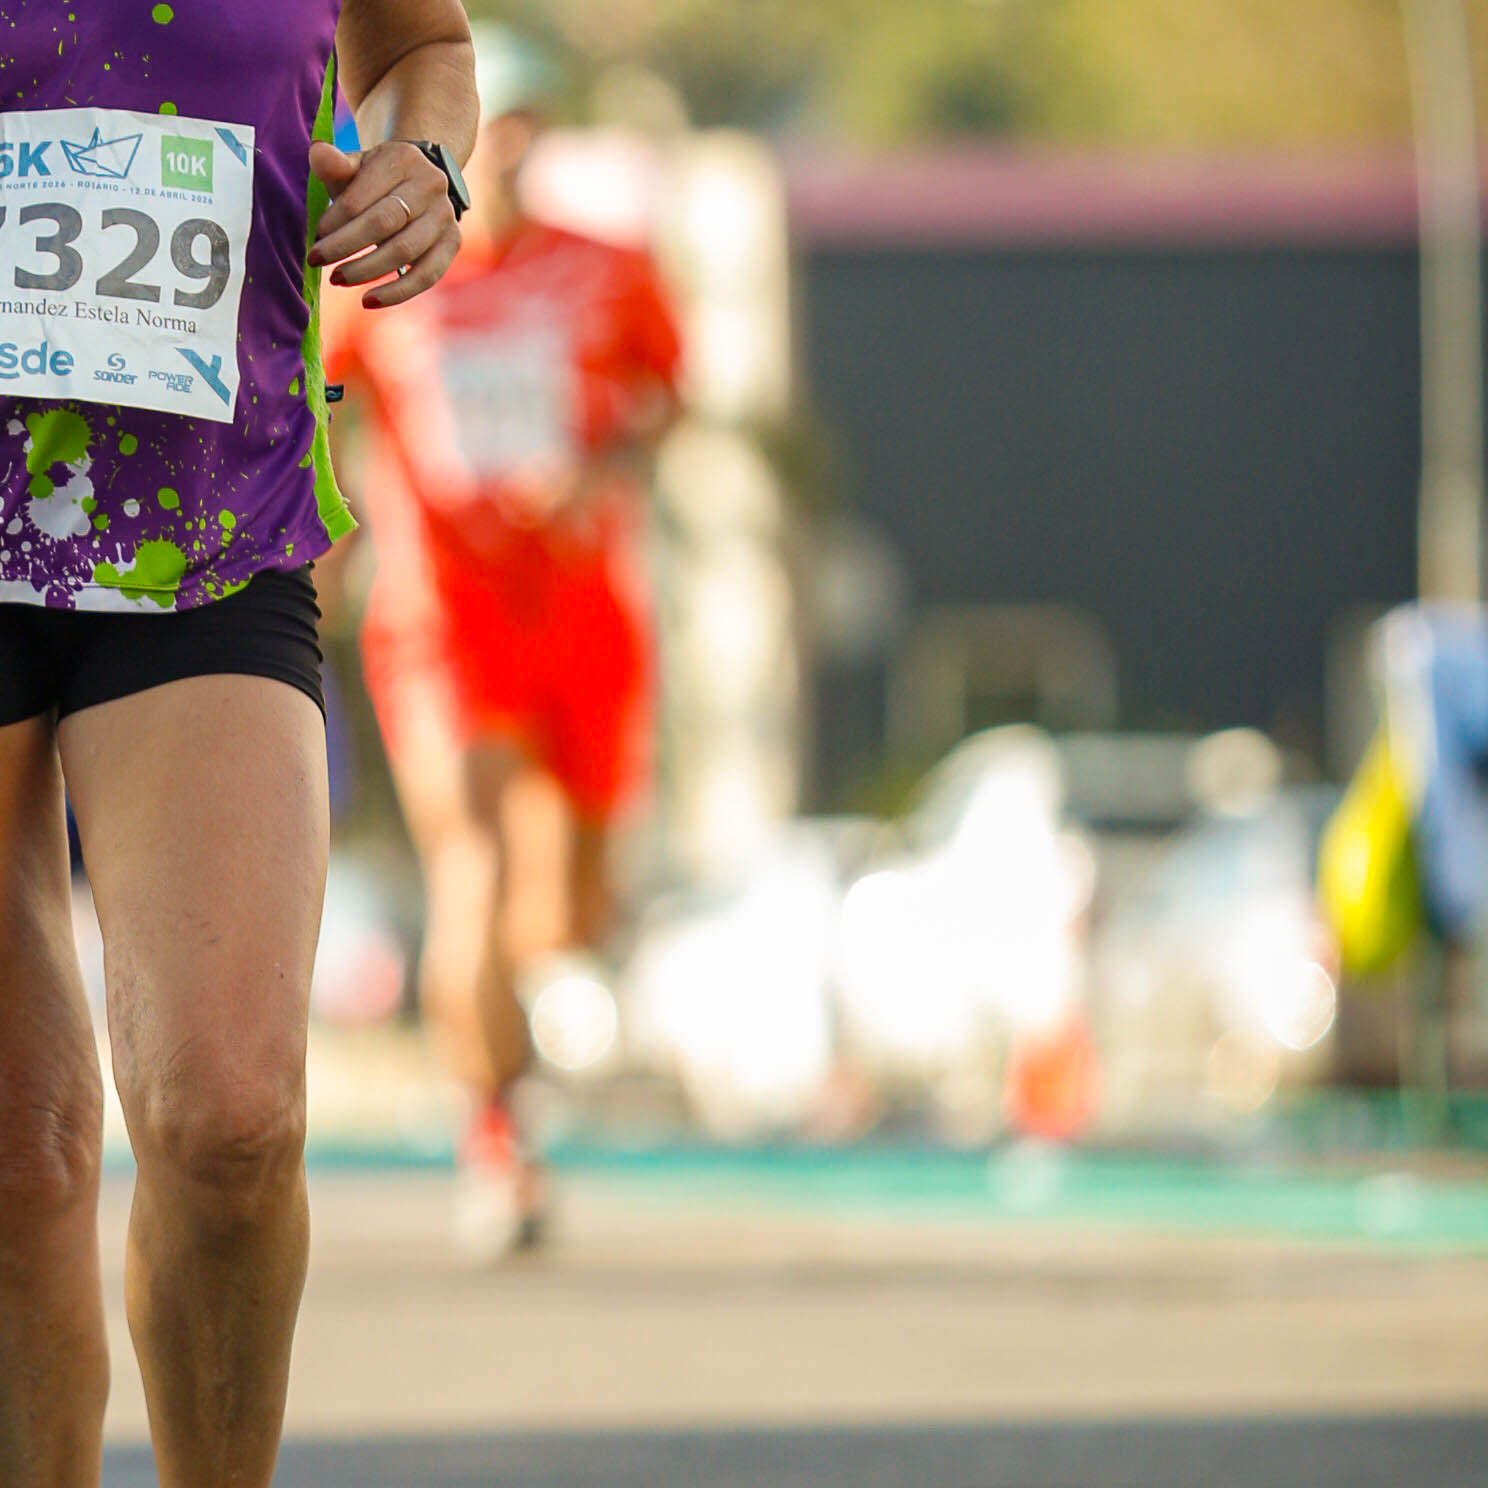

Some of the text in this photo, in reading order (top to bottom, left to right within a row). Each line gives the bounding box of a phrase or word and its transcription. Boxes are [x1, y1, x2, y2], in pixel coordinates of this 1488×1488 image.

[166, 152, 207, 177] 10K
[6, 180, 38, 190] NORTE
[42, 180, 66, 189] 2026
[77, 181, 119, 192] ROSARIO
[144, 188, 156, 196] DE
[159, 192, 188, 201] ABRIL
[191, 195, 213, 205] 2026
[75, 301, 130, 324] Estela
[136, 308, 198, 334] Norma
[148, 370, 193, 385] POWER
